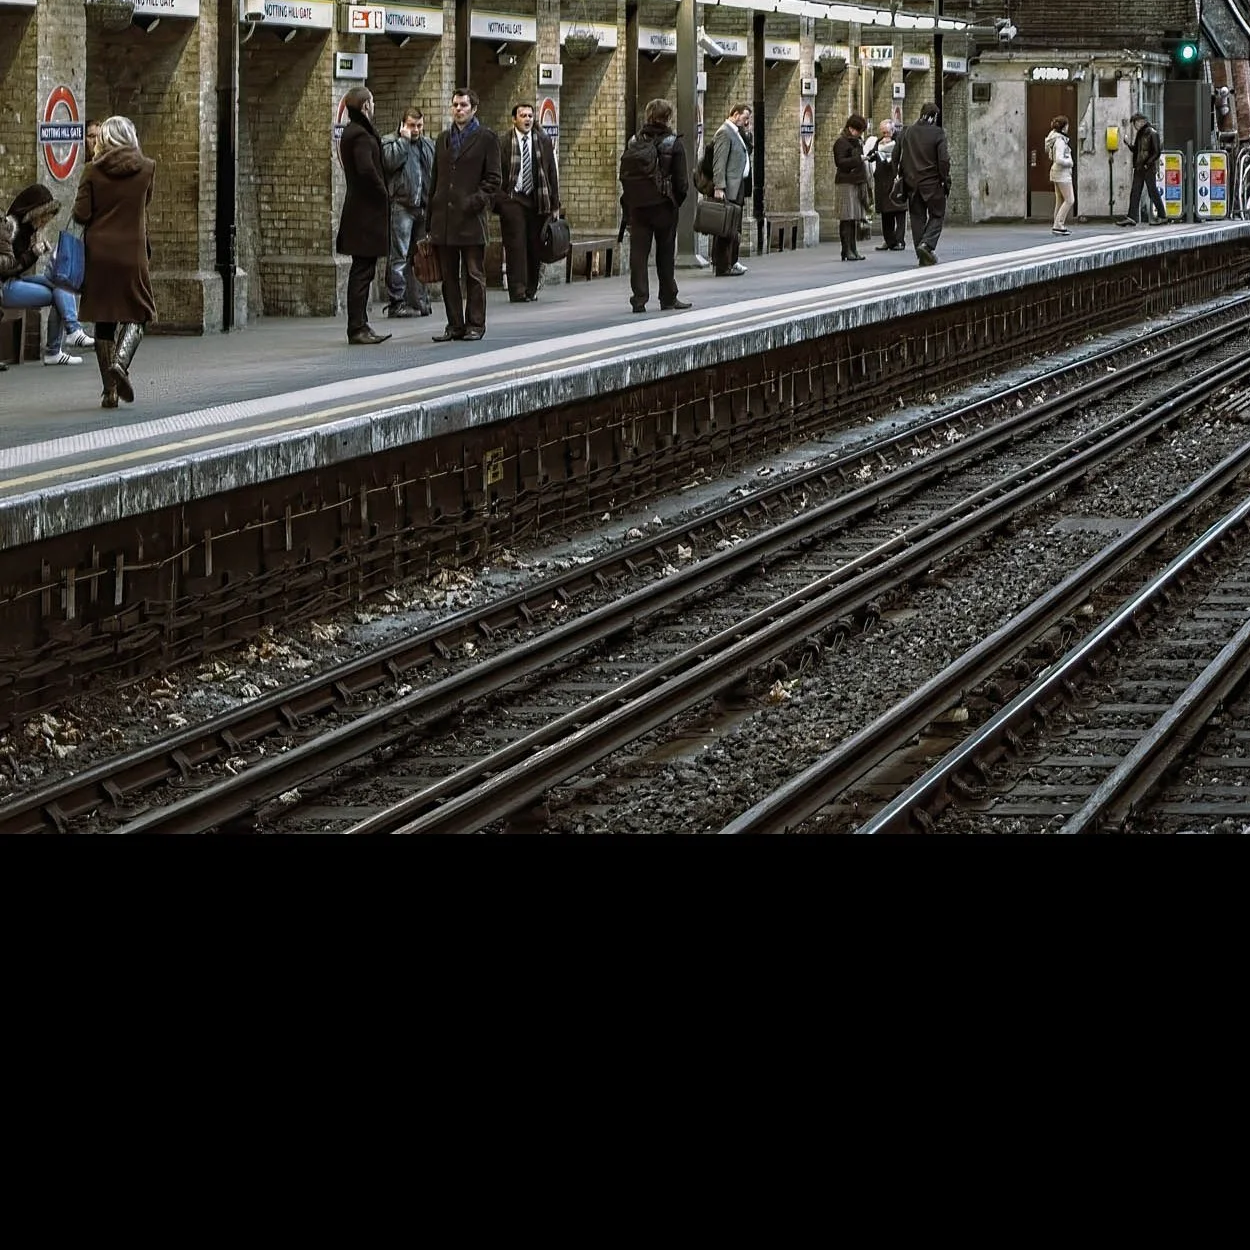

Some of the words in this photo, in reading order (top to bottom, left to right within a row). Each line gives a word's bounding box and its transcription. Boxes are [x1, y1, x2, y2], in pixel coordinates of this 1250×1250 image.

[265, 3, 287, 18] NOTTING
[288, 6, 299, 19] HILL
[300, 7, 312, 20] GATE
